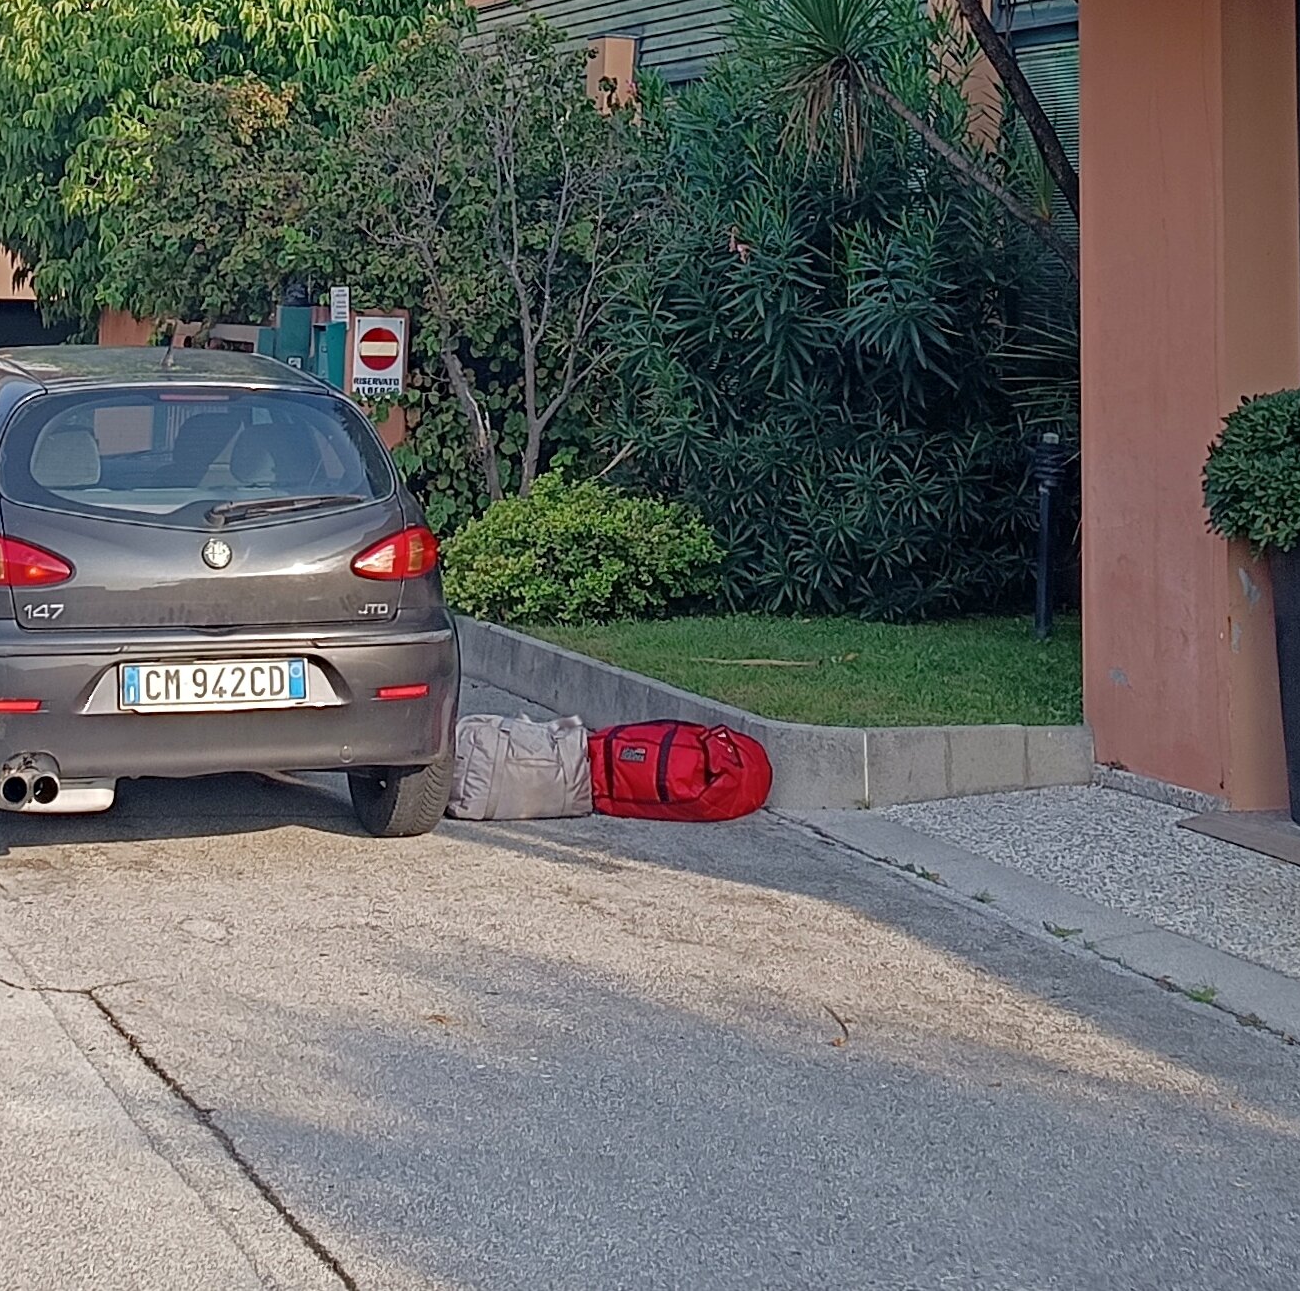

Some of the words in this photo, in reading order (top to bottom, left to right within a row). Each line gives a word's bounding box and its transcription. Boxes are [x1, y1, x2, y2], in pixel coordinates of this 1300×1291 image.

[353, 377, 400, 386] RISERVATO
[23, 604, 64, 620] 147
[358, 603, 388, 615] JTD
[145, 668, 181, 701] CM
[192, 665, 285, 699] 942CD
